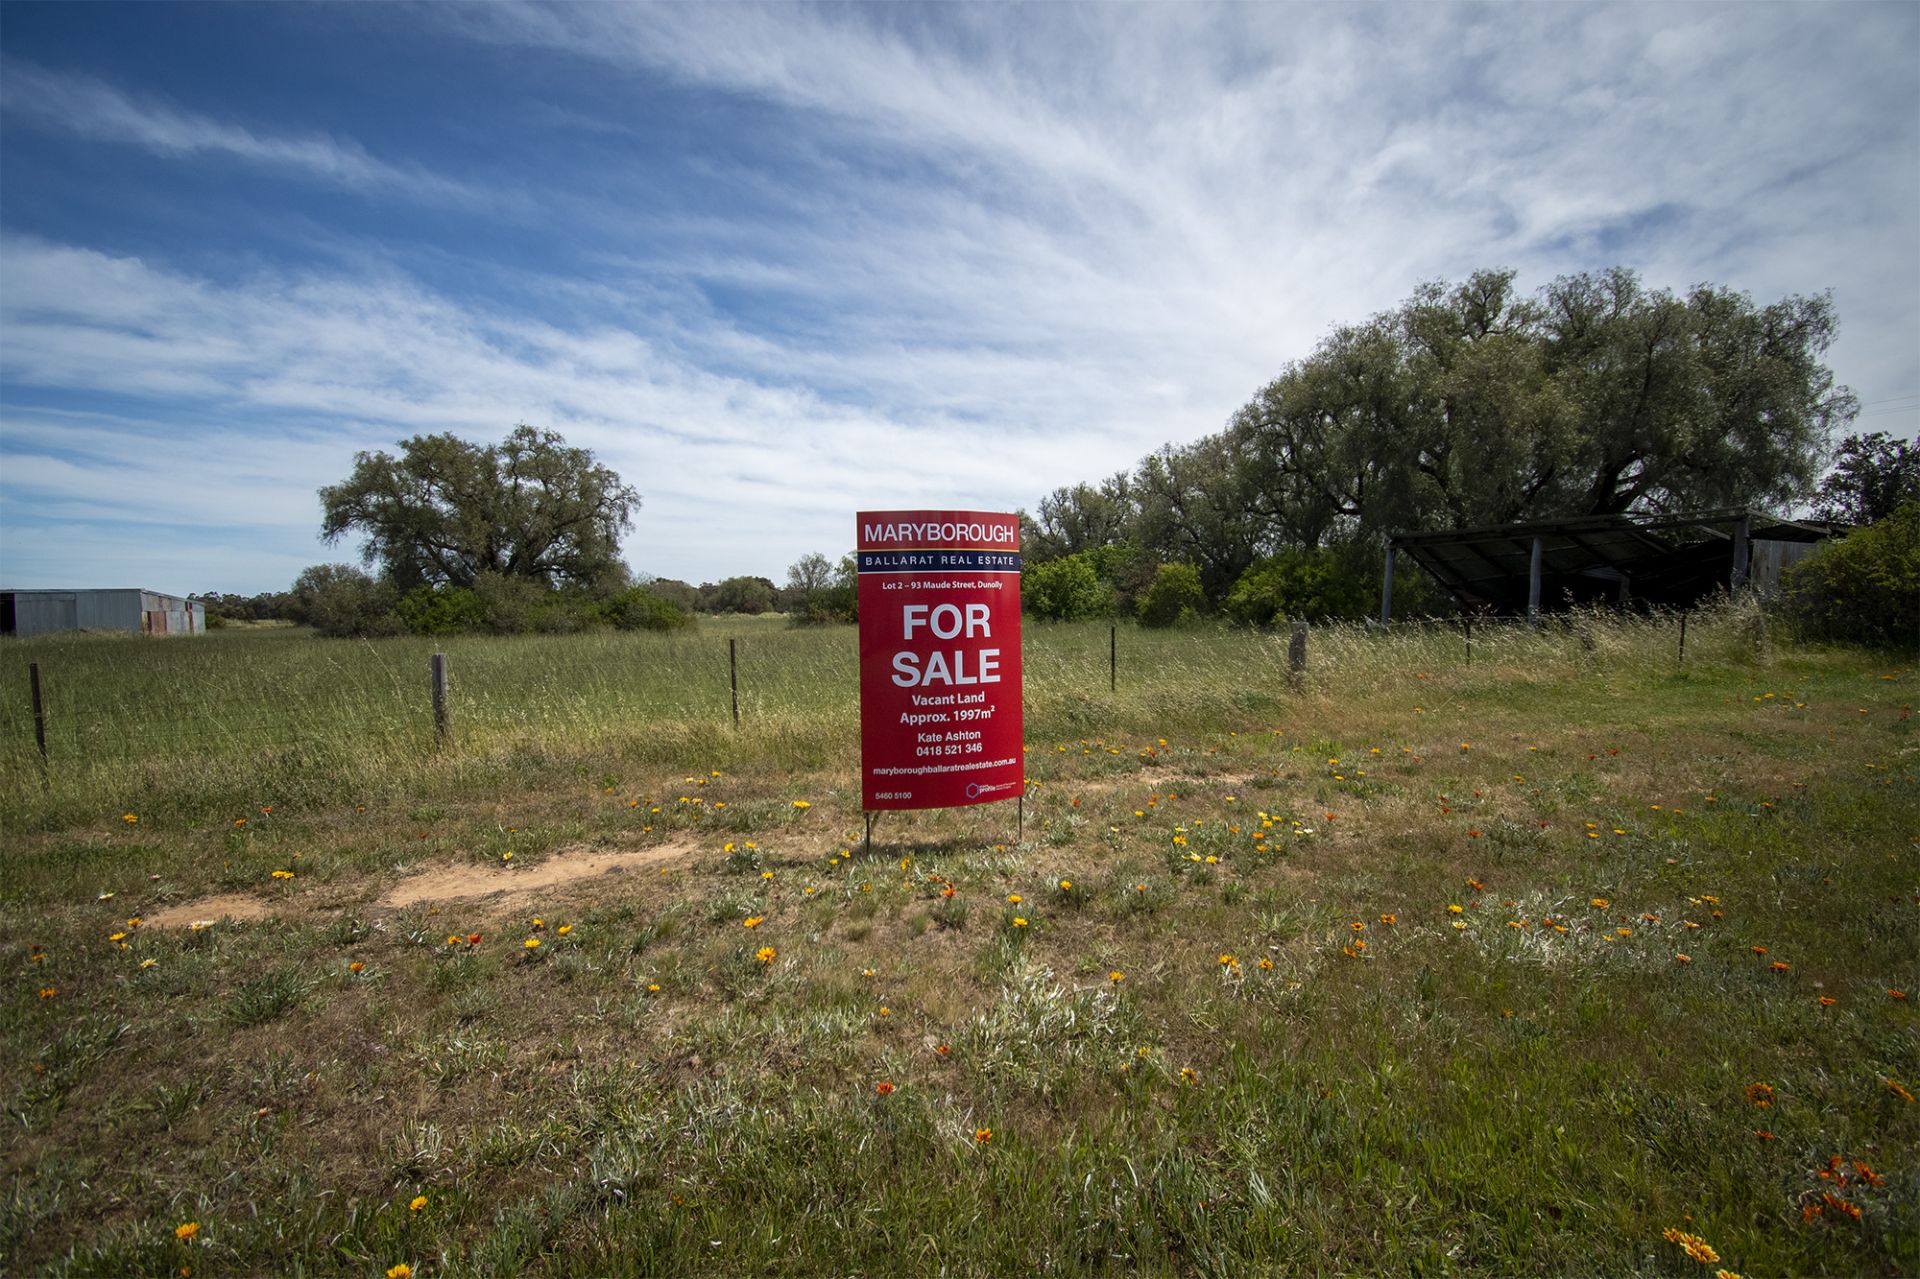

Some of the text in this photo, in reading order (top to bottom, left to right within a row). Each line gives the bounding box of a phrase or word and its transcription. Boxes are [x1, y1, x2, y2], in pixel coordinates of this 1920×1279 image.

[865, 523, 1014, 543] MARYBOROUGH
[865, 556, 1014, 566] BALLARAT REAL ESTATE
[882, 582, 896, 590] Lot
[898, 582, 904, 590] 2
[911, 582, 922, 590] 93
[923, 581, 951, 589] Maude
[952, 581, 976, 590] Street,
[977, 581, 1003, 591] Dunolly
[903, 603, 991, 640] FOR
[891, 648, 1001, 688] SALE
[912, 691, 985, 706] Vacant Land
[900, 712, 950, 726] Approx.
[917, 730, 981, 743] Kate Ashton
[916, 742, 983, 757] 0418 521 346
[873, 757, 1017, 776] maryboroughballaratrealestate.com.au
